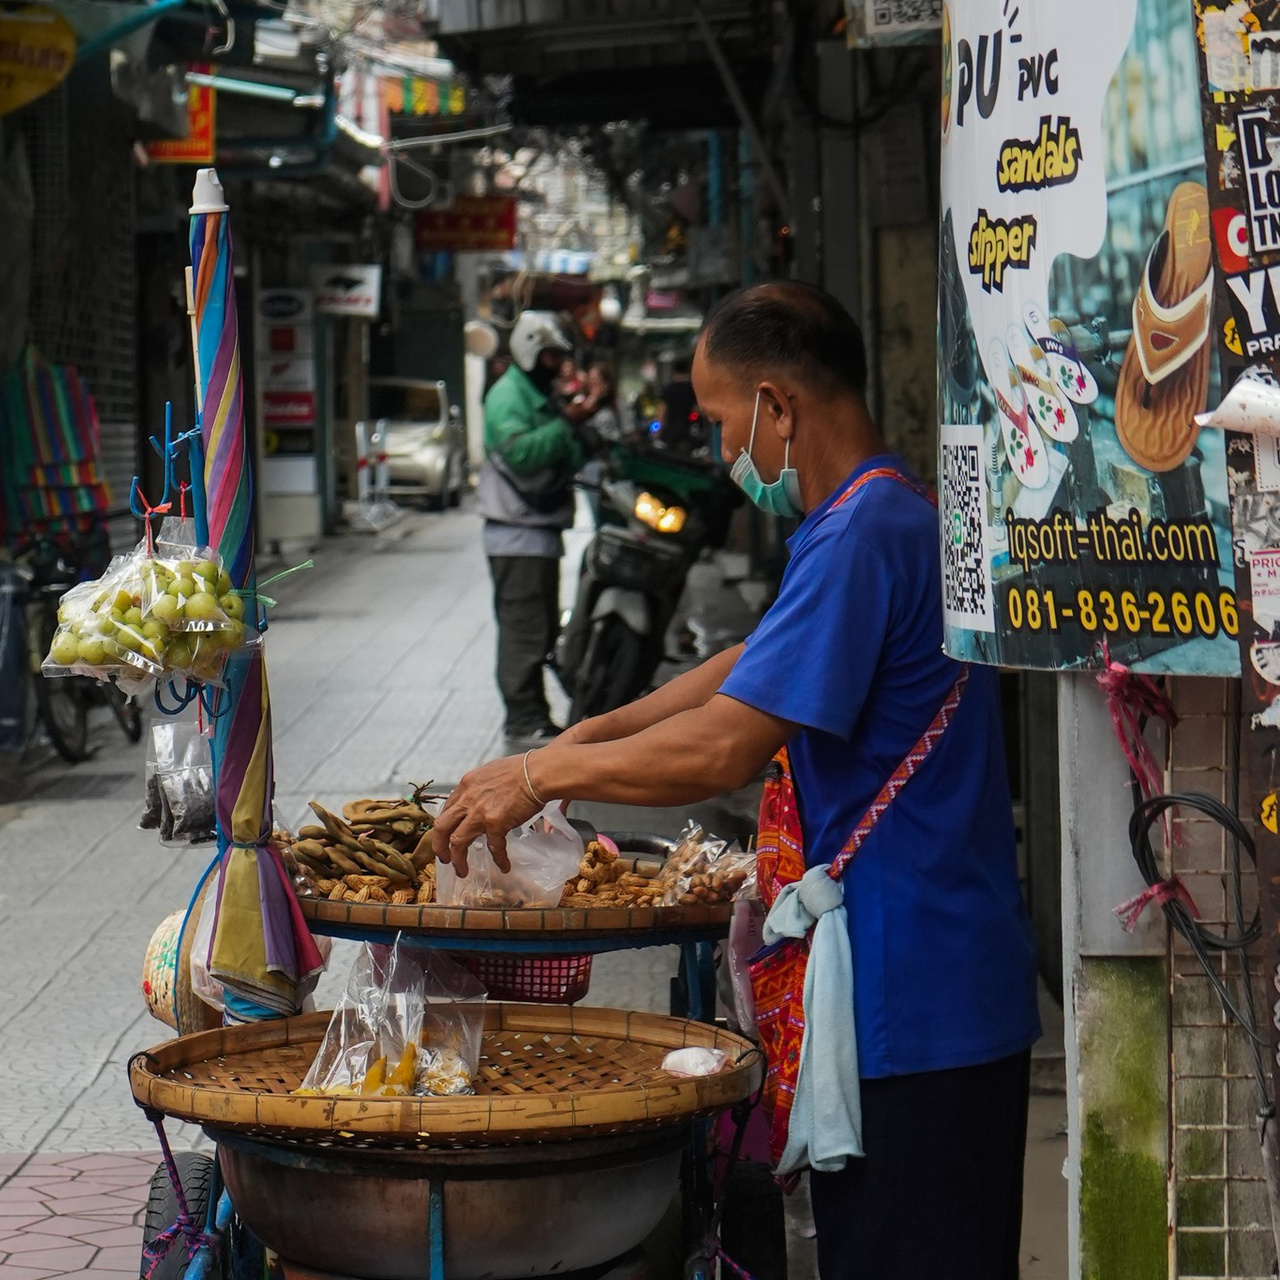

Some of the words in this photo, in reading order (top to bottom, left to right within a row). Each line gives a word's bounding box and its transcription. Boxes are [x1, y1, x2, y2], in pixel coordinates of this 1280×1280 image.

[957, 29, 1003, 128] PU
[1018, 48, 1059, 101] PVC
[998, 118, 1081, 191] sandals
[969, 211, 1036, 292] slipper
[1007, 512, 1217, 572] iqsoft-thai.com
[1008, 587, 1239, 636] 081-836-2606
